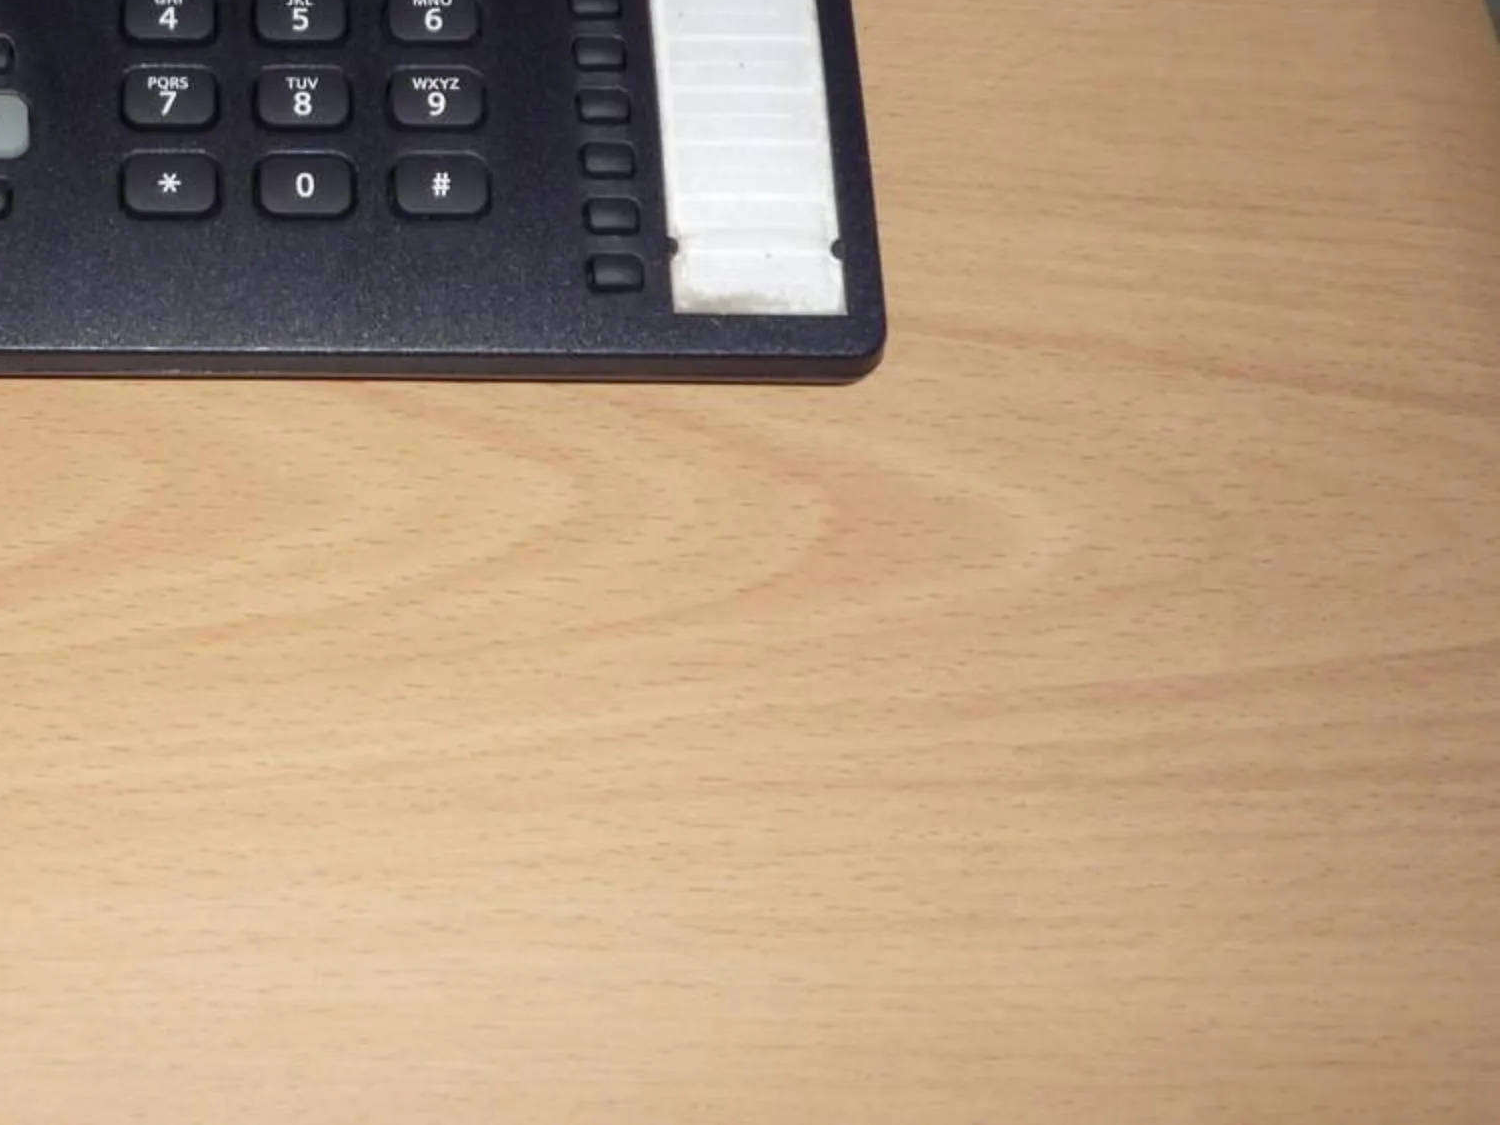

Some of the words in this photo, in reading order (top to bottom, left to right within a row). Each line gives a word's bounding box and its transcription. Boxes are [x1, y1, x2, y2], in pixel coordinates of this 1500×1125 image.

[158, 6, 178, 30] 4
[292, 7, 309, 32] 5
[424, 7, 443, 32] 6
[147, 76, 189, 91] PQRS
[286, 76, 319, 90] TUV
[411, 77, 460, 90] WXYZ
[159, 89, 177, 116] 7
[293, 91, 313, 116] 8
[427, 91, 446, 117] 9
[295, 172, 315, 198] 0
